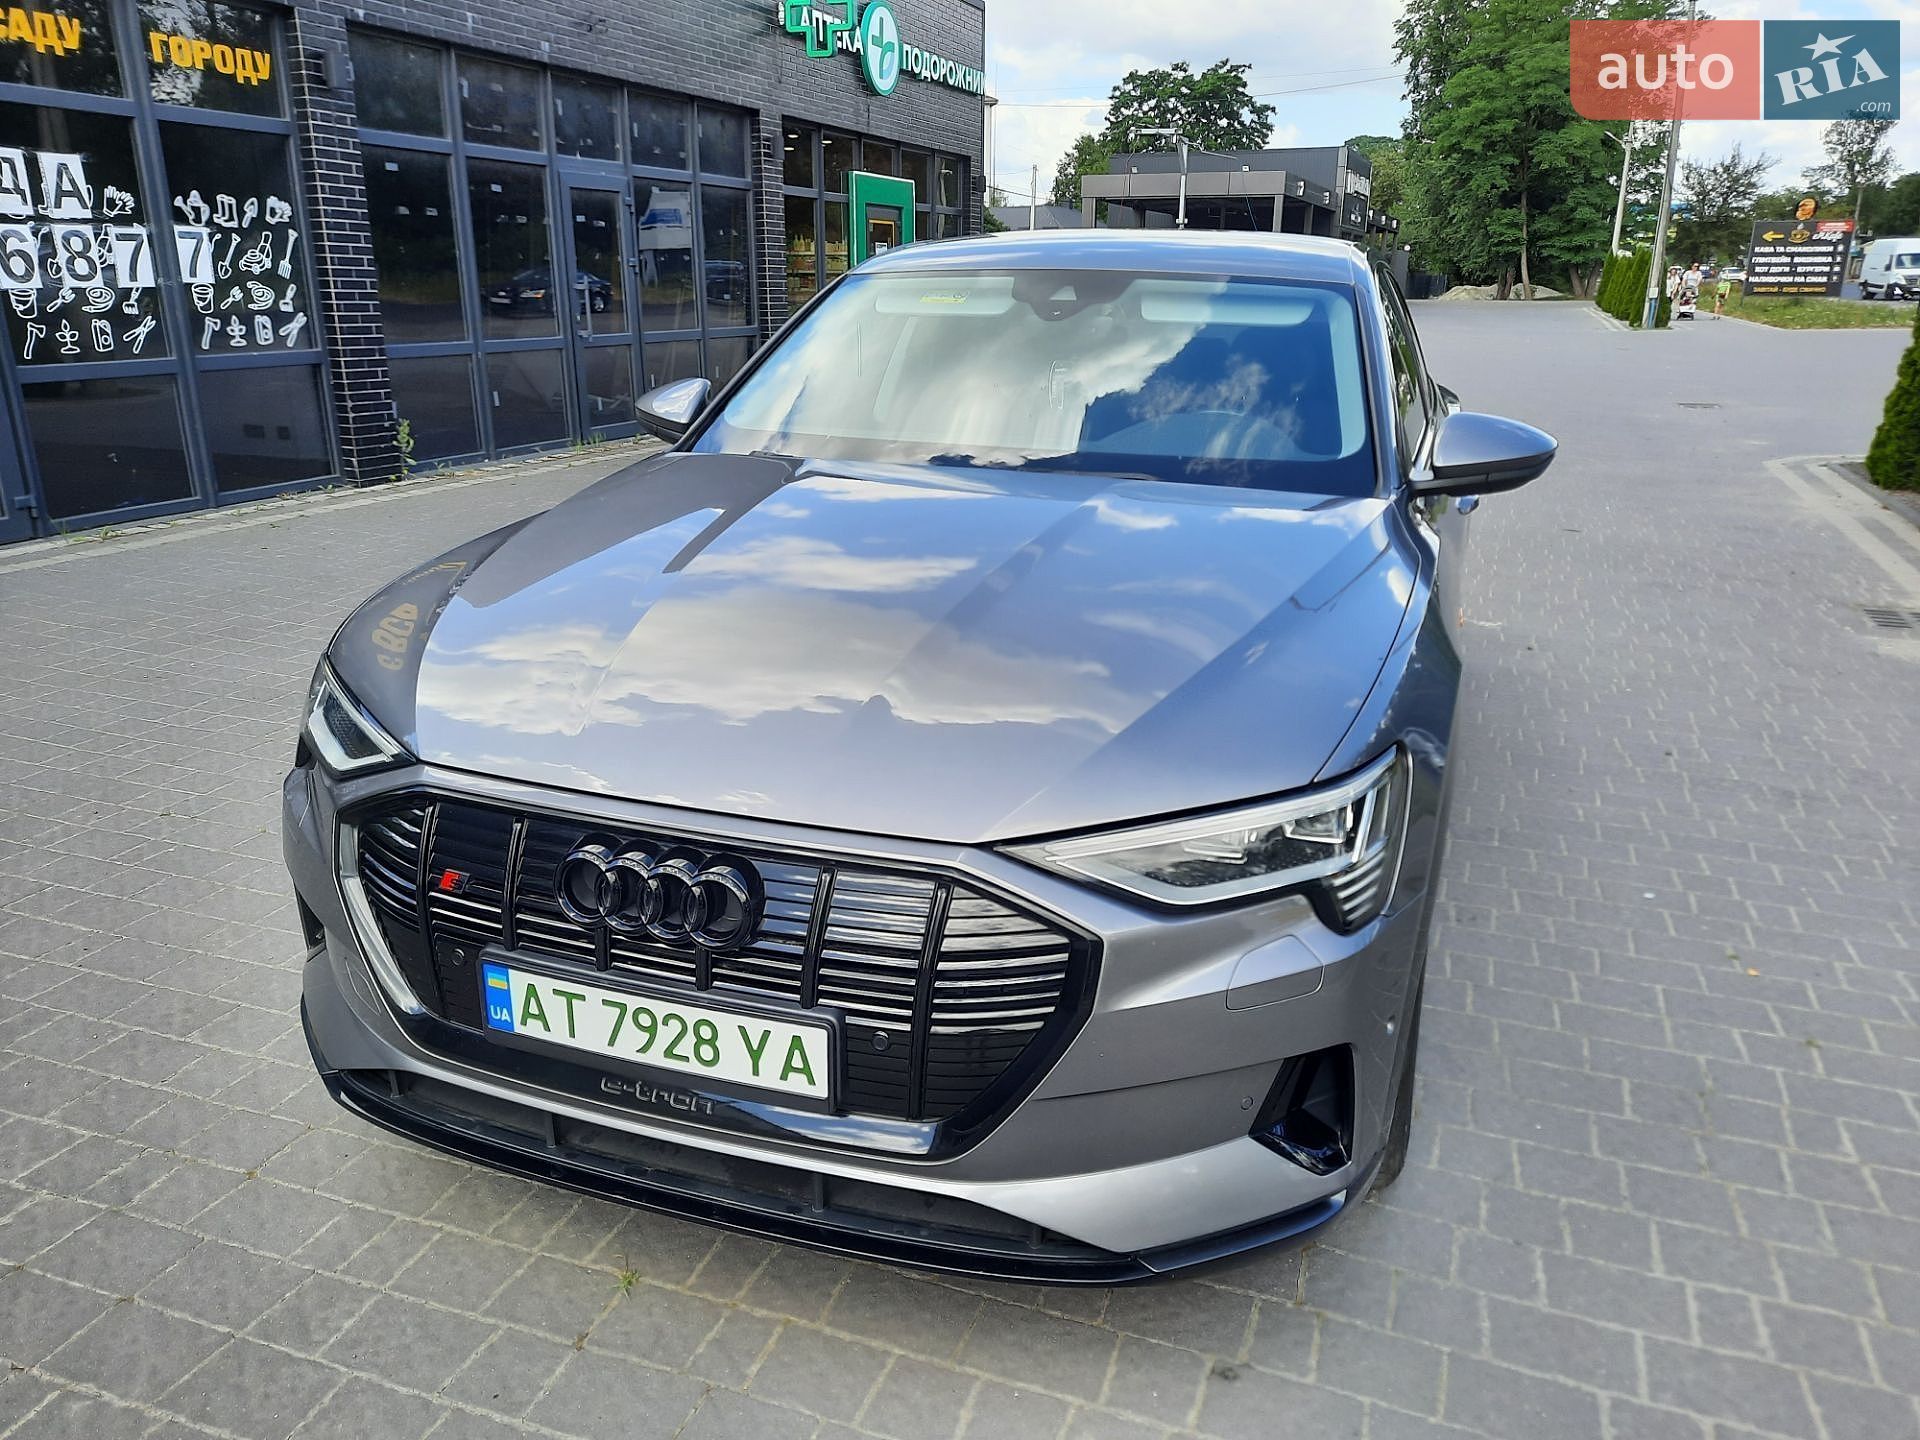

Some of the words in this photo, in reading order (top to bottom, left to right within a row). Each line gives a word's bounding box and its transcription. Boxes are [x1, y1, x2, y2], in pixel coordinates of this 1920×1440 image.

[150, 32, 271, 86] ГОРОДУ
[489, 1004, 511, 1023] UA
[519, 982, 586, 1039] AT
[601, 998, 720, 1068] 7928
[737, 1024, 817, 1086] YA
[600, 1077, 713, 1115] e-tron
